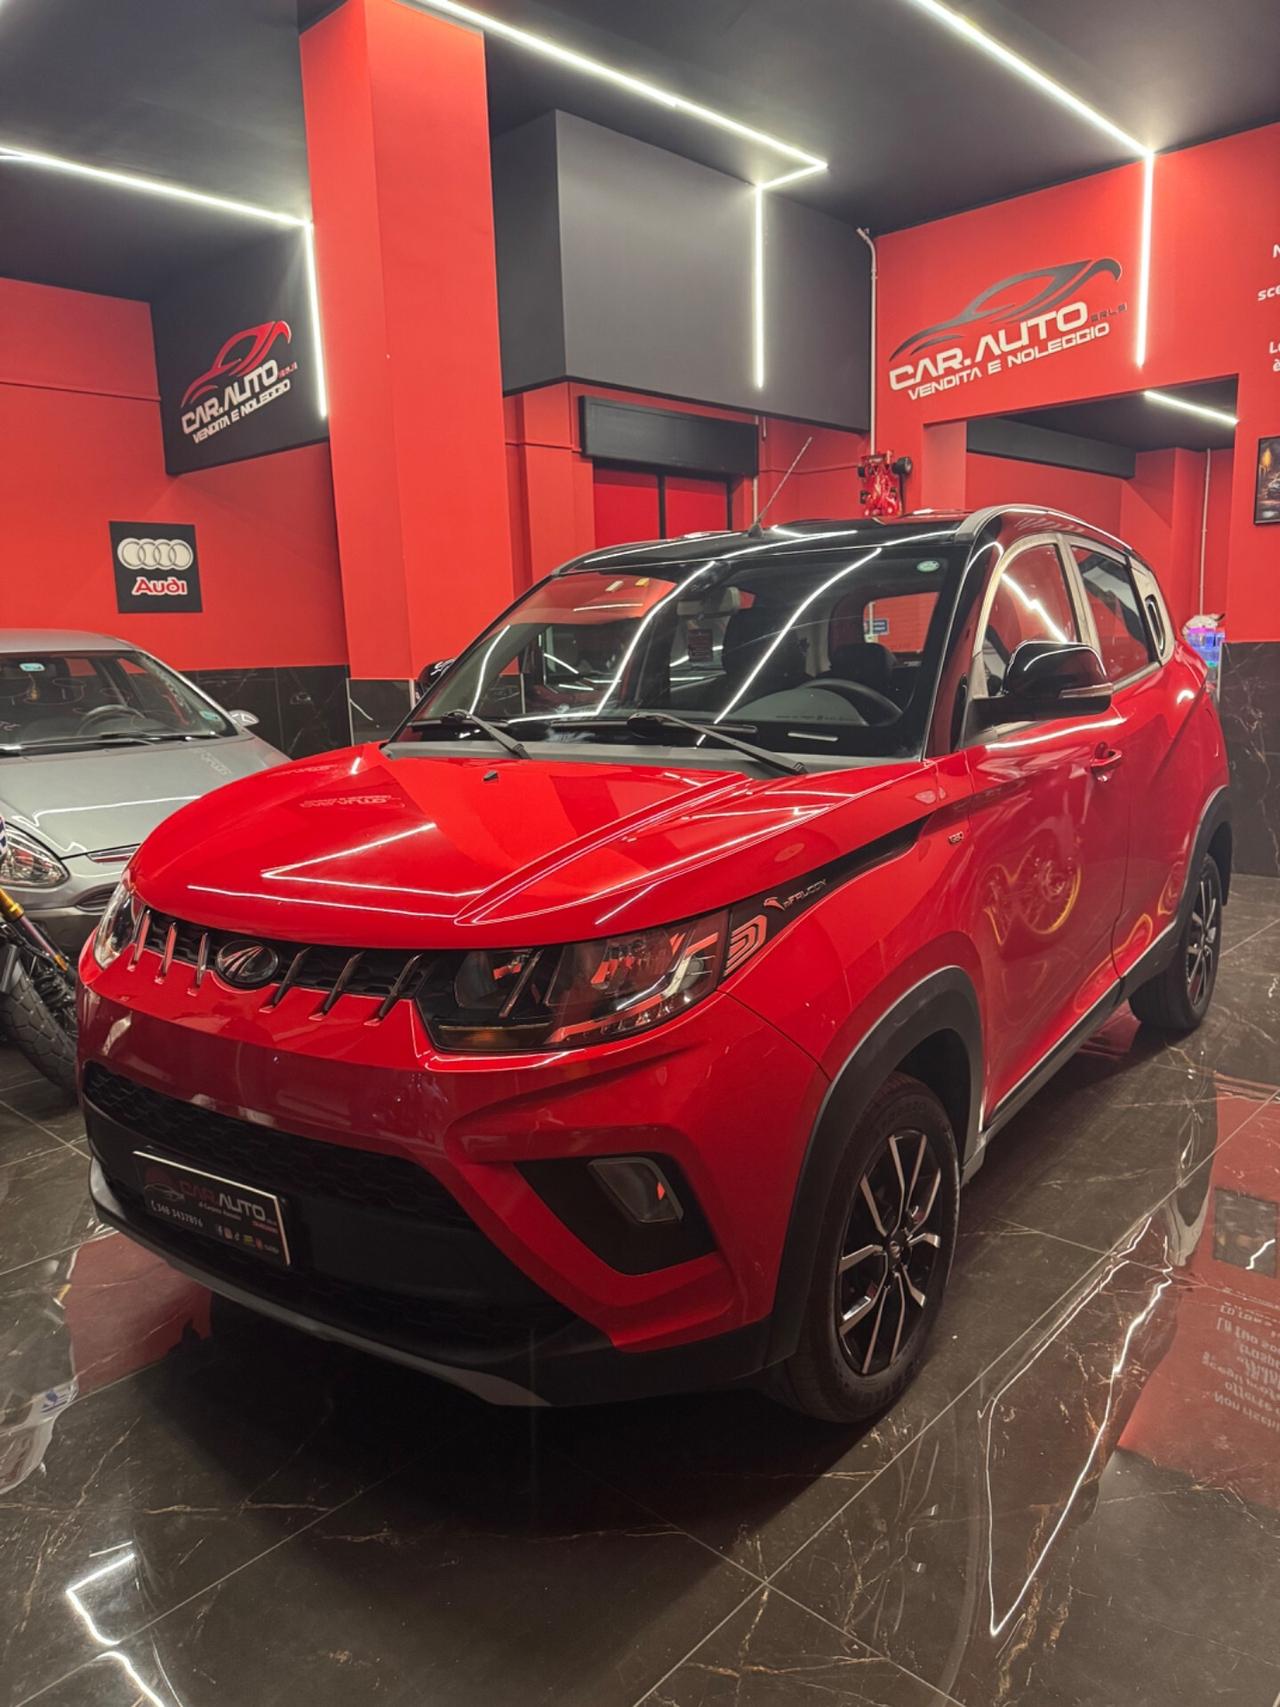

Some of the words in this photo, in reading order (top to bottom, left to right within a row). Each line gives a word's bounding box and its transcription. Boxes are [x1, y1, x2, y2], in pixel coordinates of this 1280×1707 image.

[908, 367, 982, 400] VENDITA
[988, 360, 1002, 375] E
[1007, 322, 1110, 369] NOLEGGIO
[193, 416, 231, 444] VENDITA
[231, 411, 240, 423] E
[240, 379, 291, 418] NOLEGGIO
[132, 576, 187, 595] Audi
